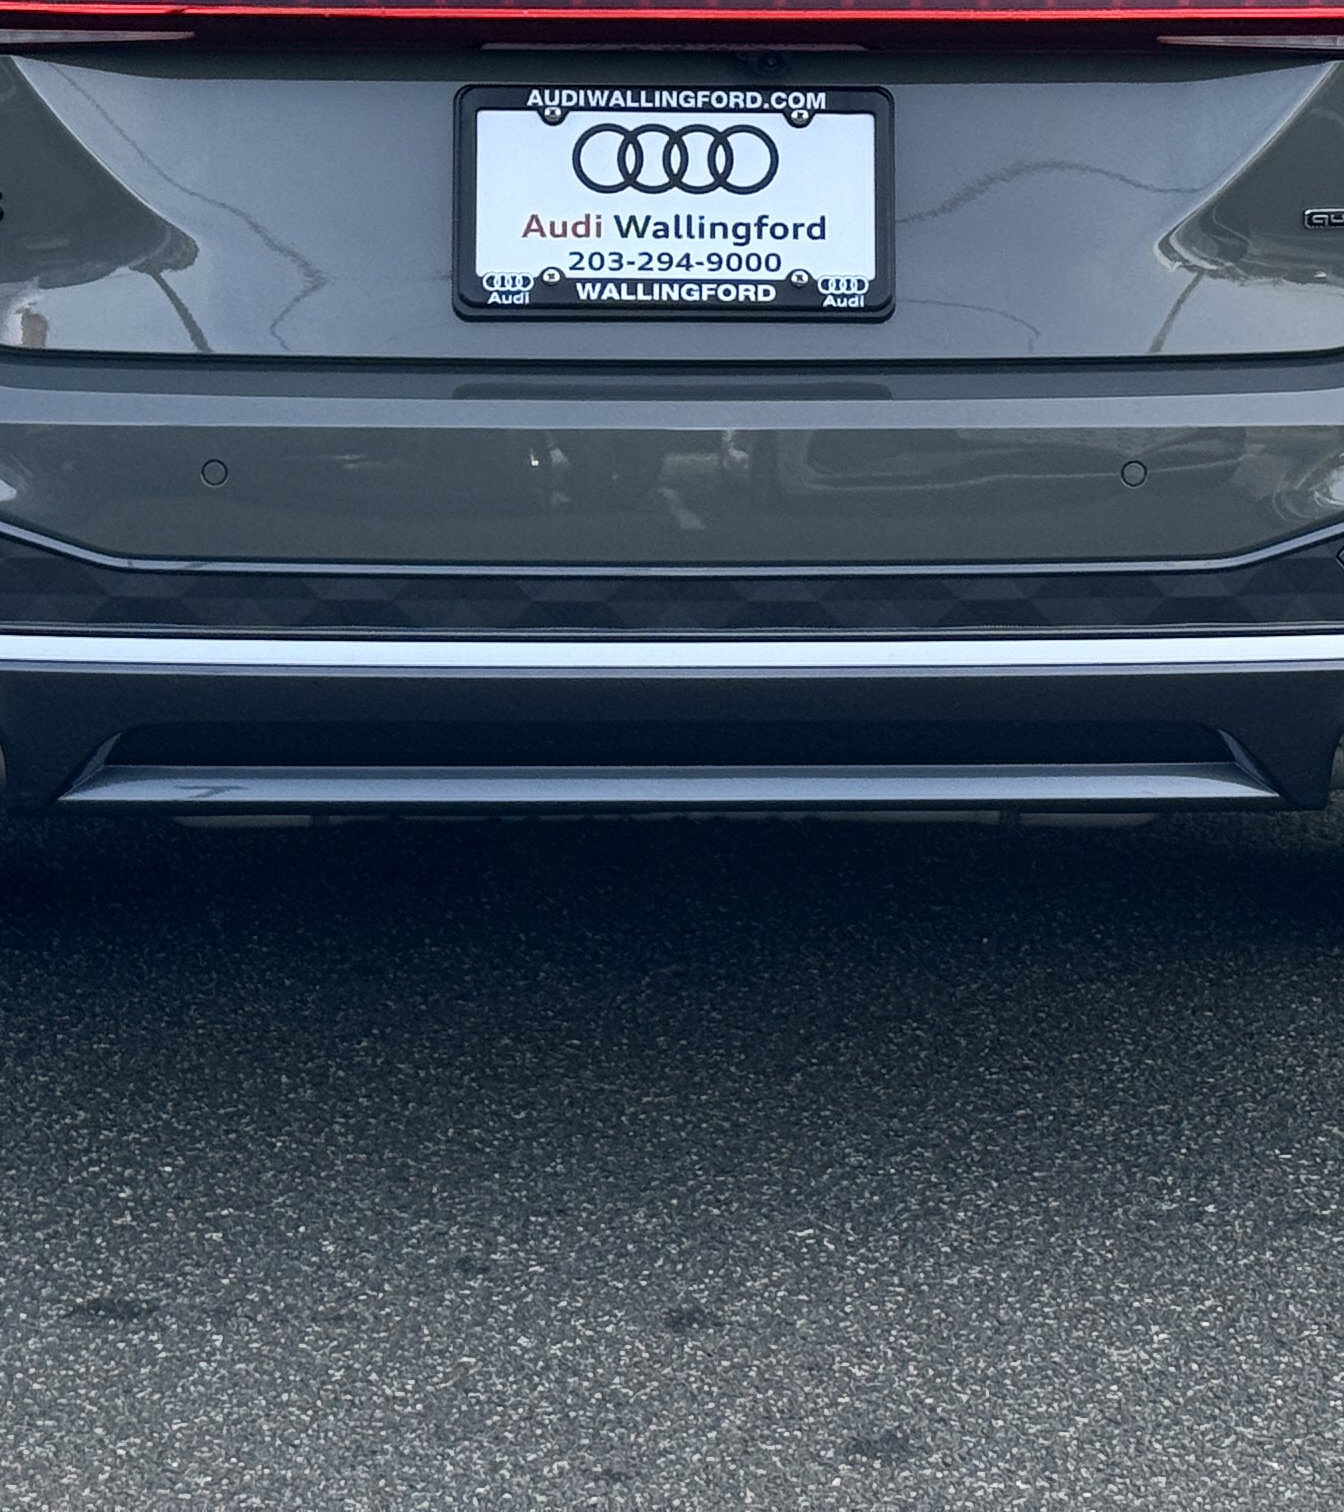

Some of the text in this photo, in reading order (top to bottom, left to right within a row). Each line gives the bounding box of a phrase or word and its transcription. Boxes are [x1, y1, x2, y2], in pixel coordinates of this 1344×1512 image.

[527, 89, 827, 110] AUDIWALLINGFORD.COM
[522, 213, 828, 246] Audi Wallingford
[568, 251, 782, 273] 203-294-9000
[487, 291, 530, 305] Audi
[575, 282, 777, 303] WALLINGFORD
[822, 294, 865, 308] Audi
